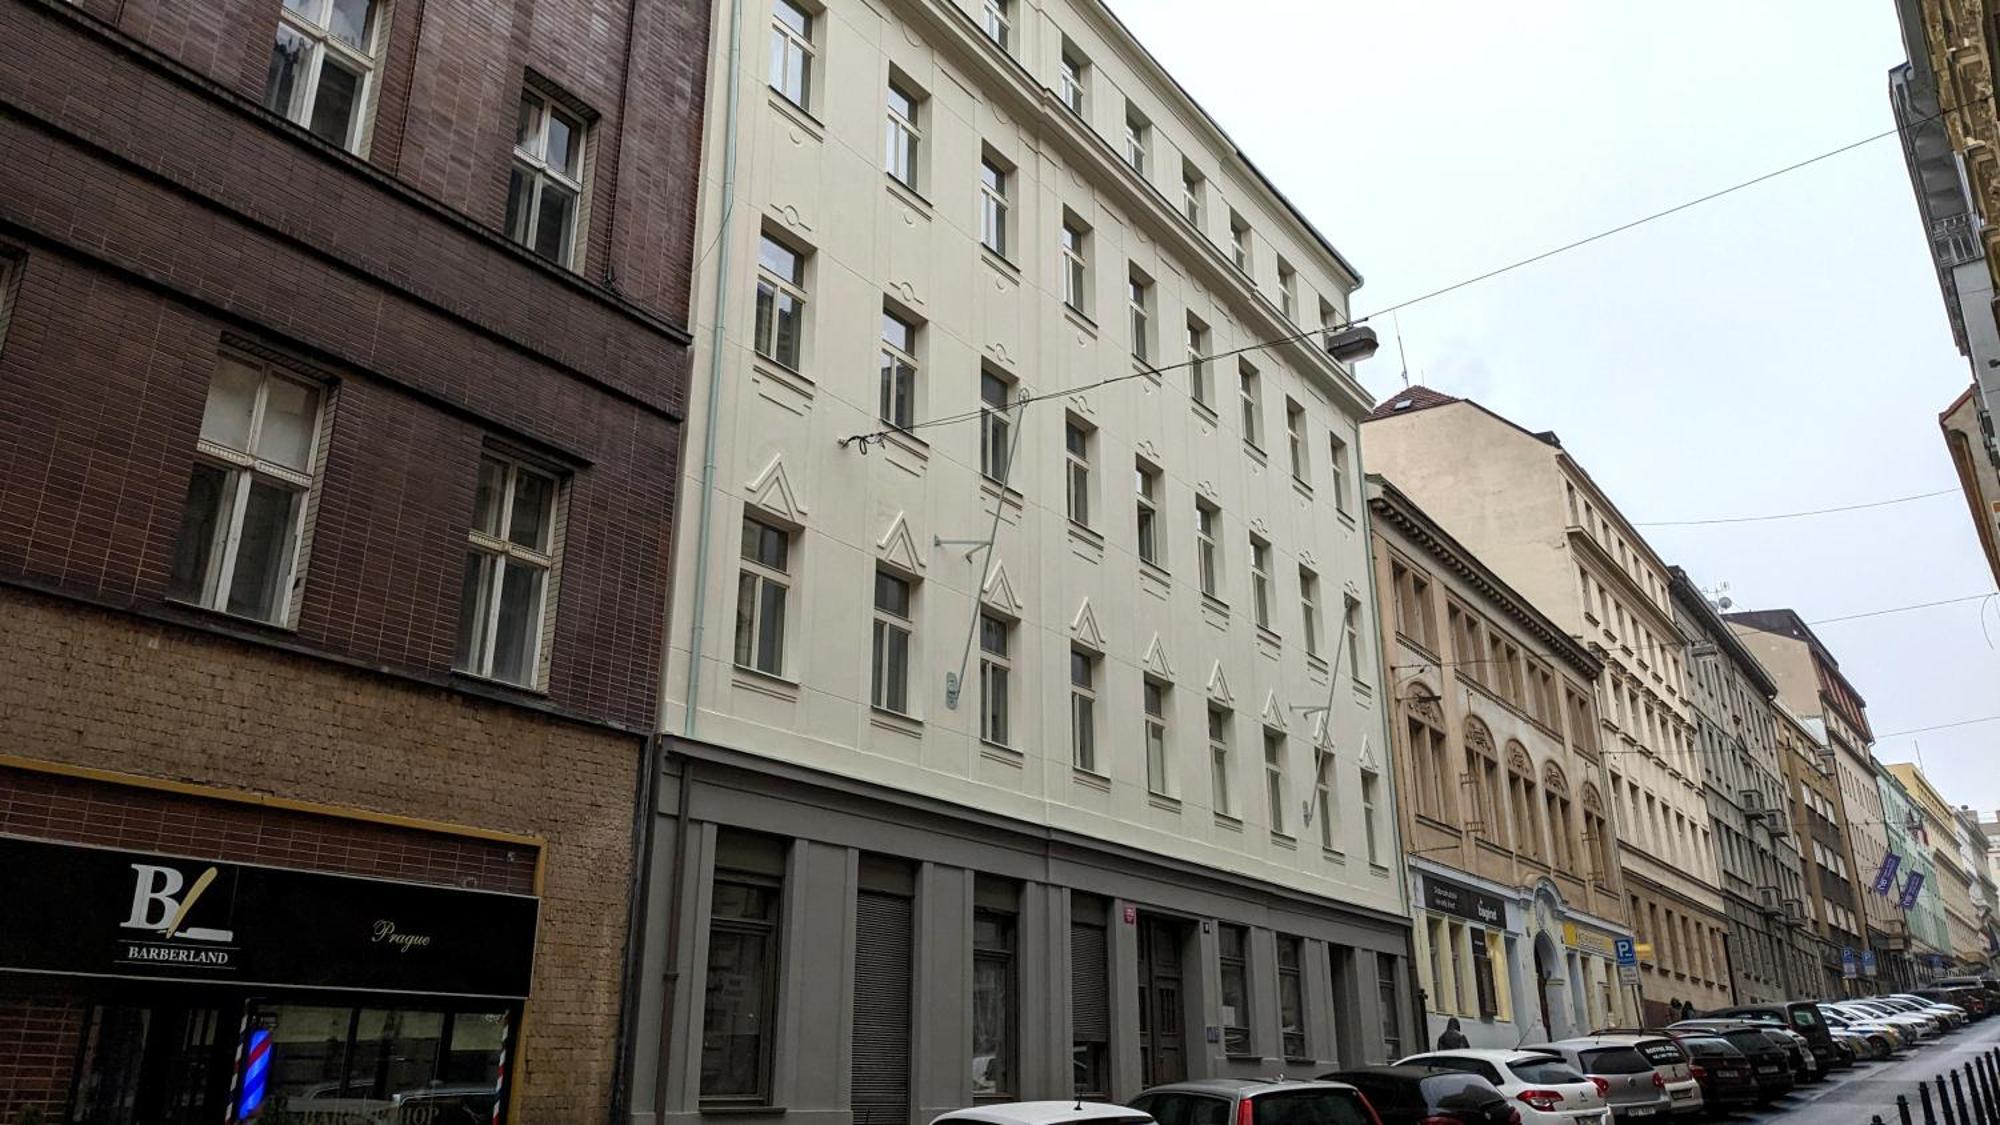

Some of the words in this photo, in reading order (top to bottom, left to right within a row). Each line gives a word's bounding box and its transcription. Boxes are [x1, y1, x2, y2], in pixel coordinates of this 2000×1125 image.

[371, 919, 431, 953] Prague
[128, 946, 229, 965] BARBERLAND
[1617, 941, 1629, 957] P
